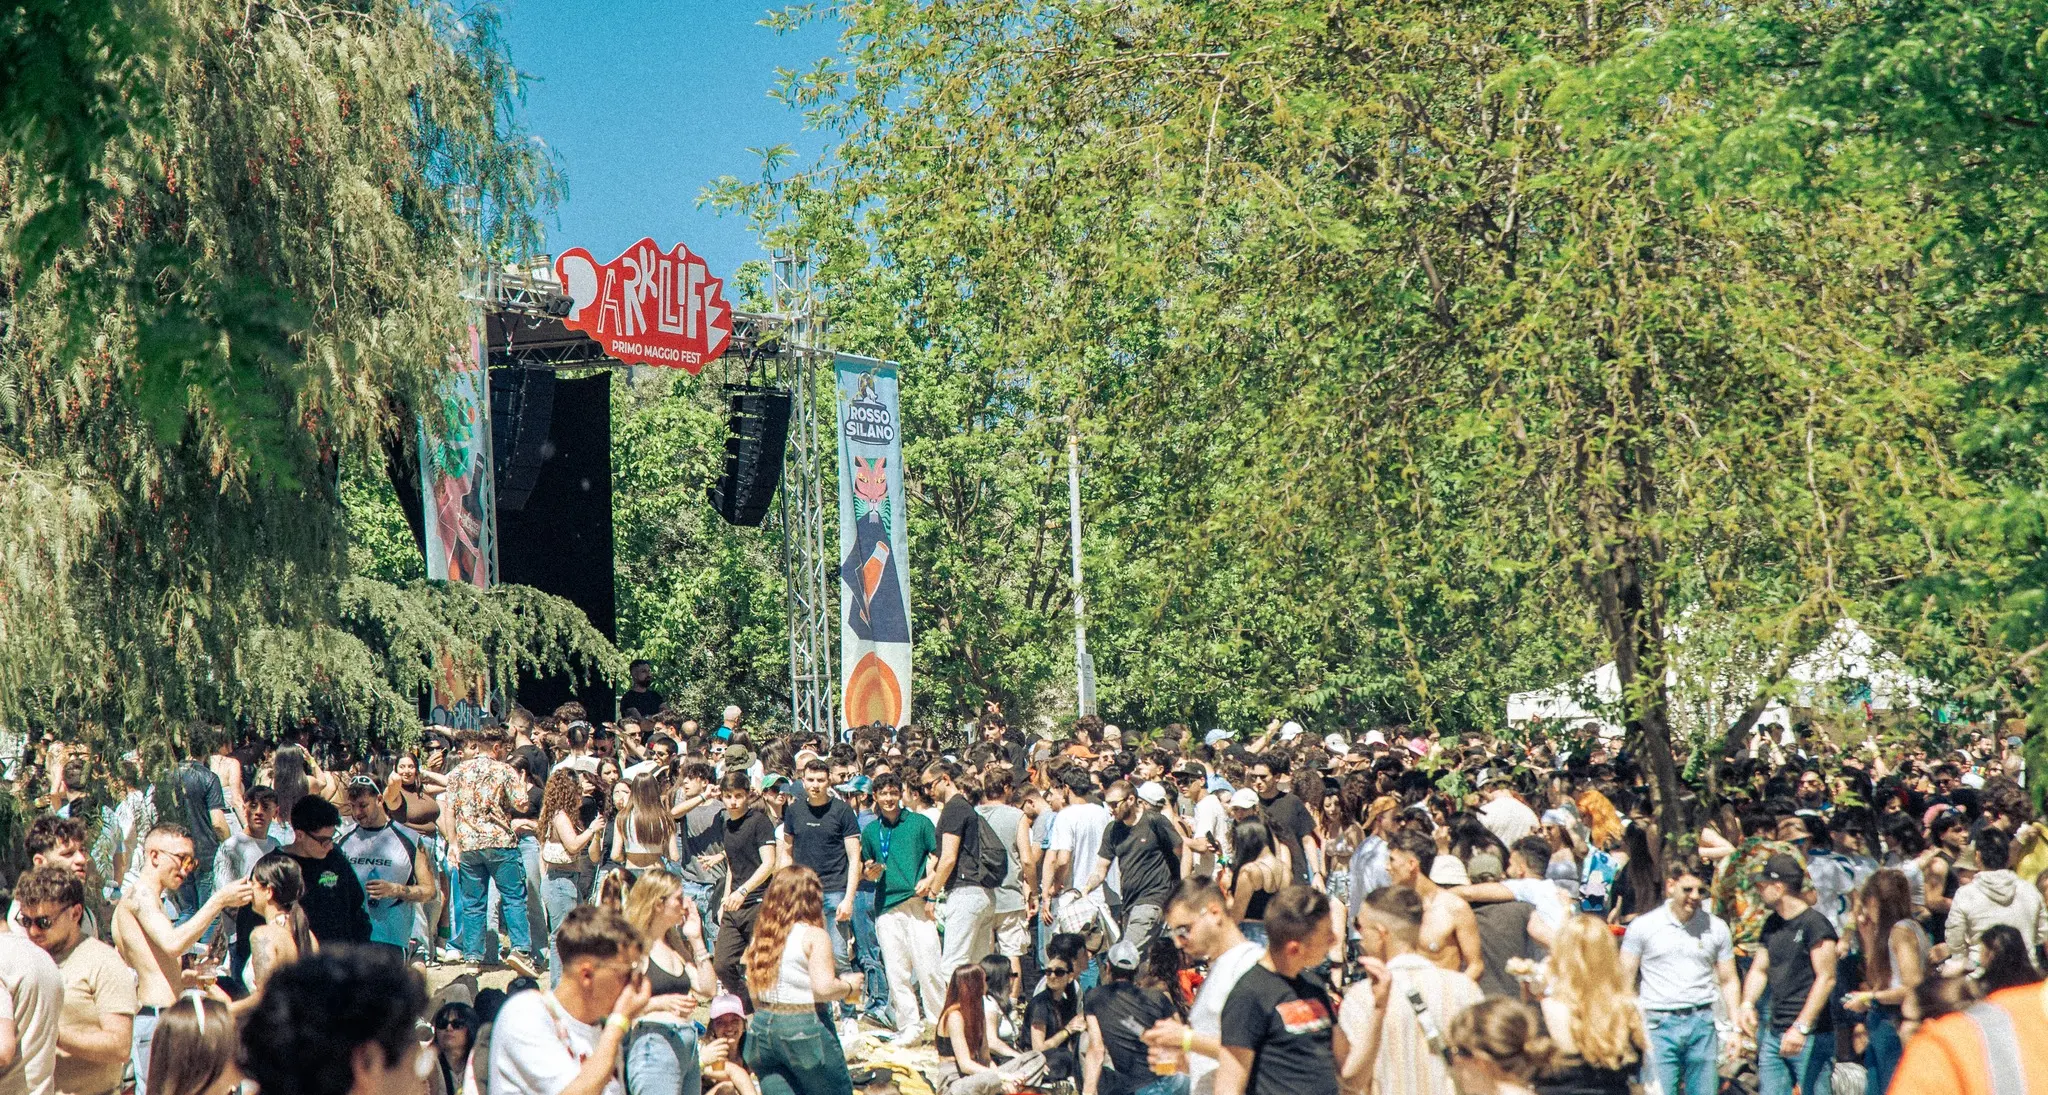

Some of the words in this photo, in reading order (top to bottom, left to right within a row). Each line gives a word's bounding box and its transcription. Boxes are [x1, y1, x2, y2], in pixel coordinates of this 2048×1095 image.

[612, 340, 642, 356] PRIMO
[644, 345, 680, 361] MAGGIO
[681, 351, 702, 365] FEST
[850, 405, 890, 425] ROSSO
[846, 421, 894, 441] SILANO
